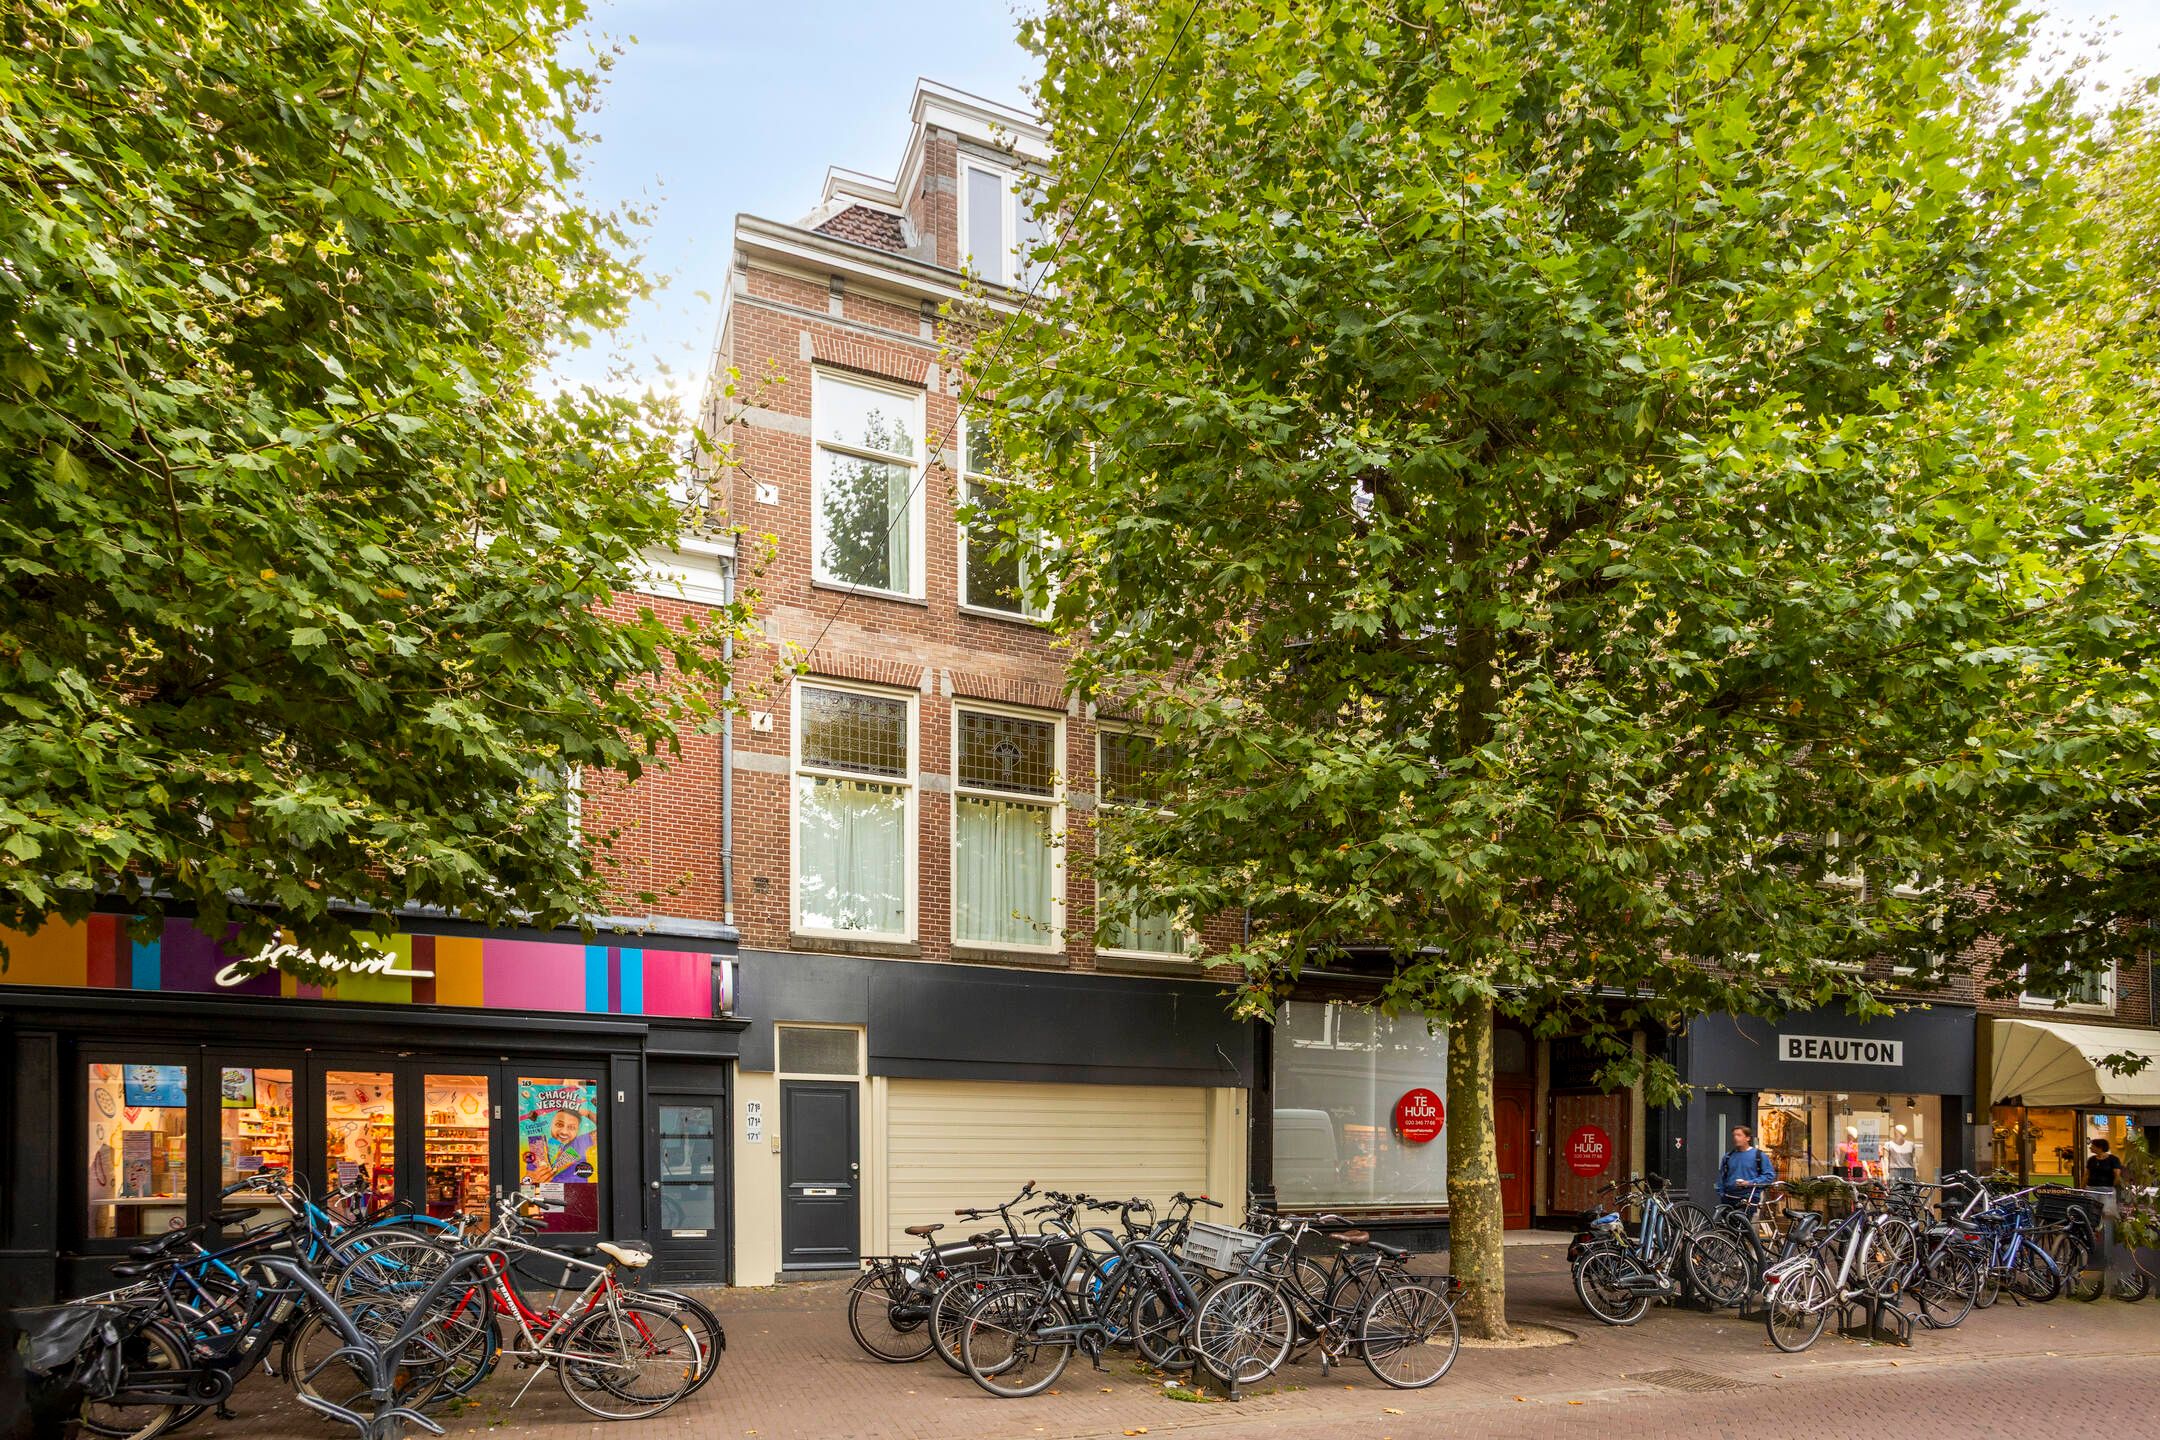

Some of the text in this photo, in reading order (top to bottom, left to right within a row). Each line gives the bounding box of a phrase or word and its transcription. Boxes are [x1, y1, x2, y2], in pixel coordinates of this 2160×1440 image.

[1788, 1038, 1895, 1063] BEAUTON
[538, 1090, 580, 1102] CHACHI
[1414, 1096, 1427, 1106] TE
[1404, 1106, 1436, 1117] HUUR
[1582, 1133, 1595, 1144] TE
[1574, 1143, 1603, 1153] HUUR
